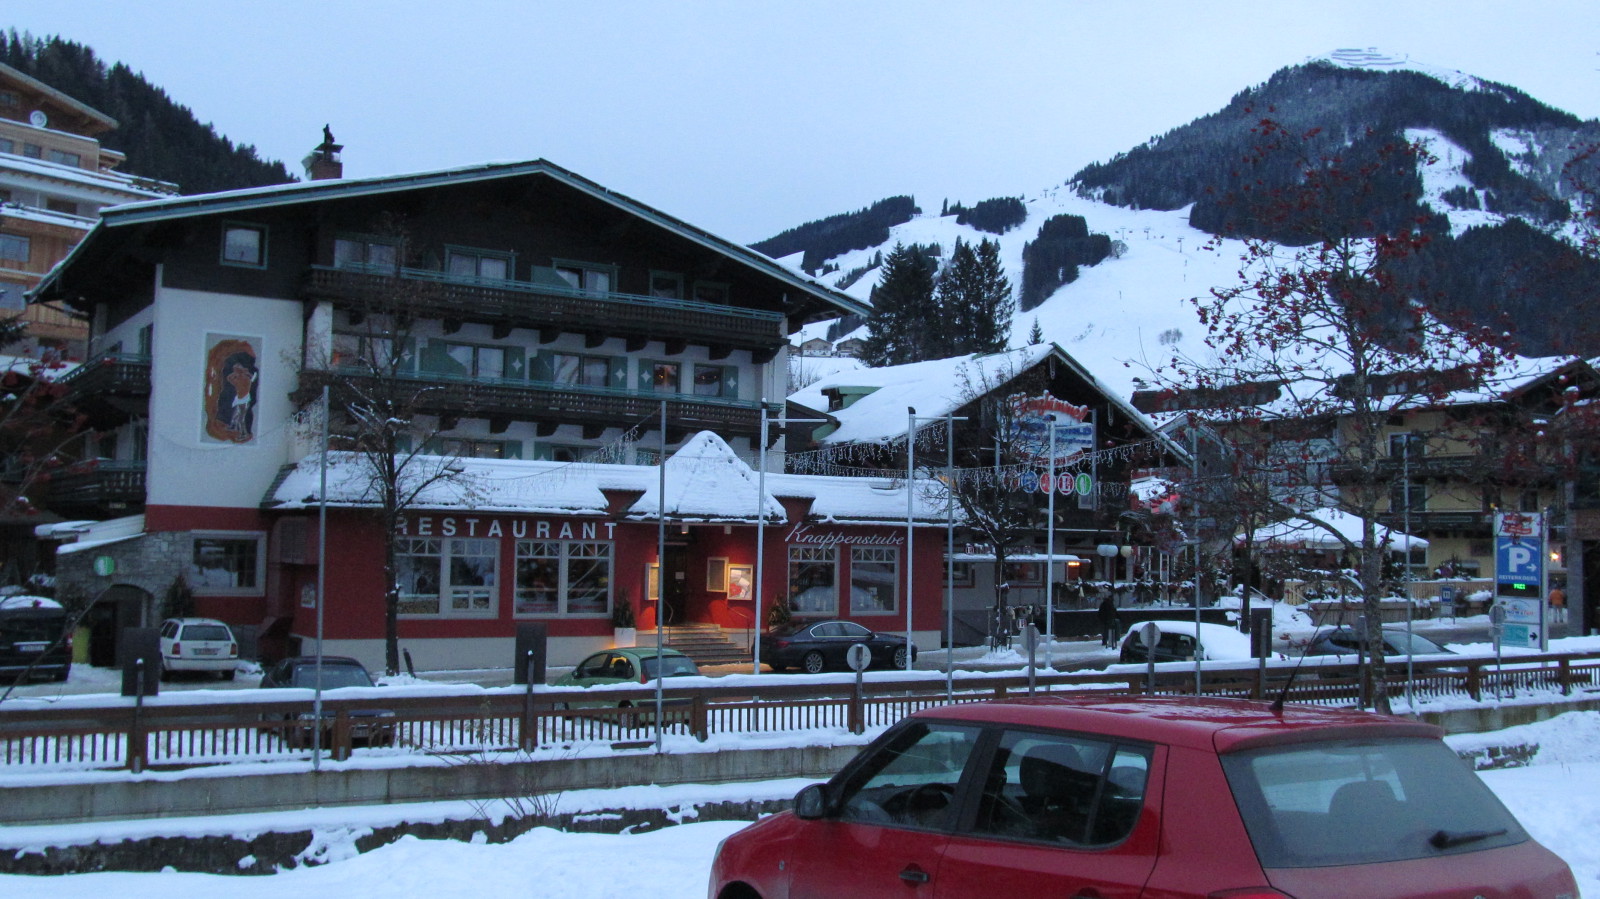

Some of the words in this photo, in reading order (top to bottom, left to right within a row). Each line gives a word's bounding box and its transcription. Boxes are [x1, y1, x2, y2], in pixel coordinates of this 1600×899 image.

[395, 516, 617, 540] RESTAURANT
[785, 521, 905, 550] Knappenstube
[1508, 547, 1531, 573] P
